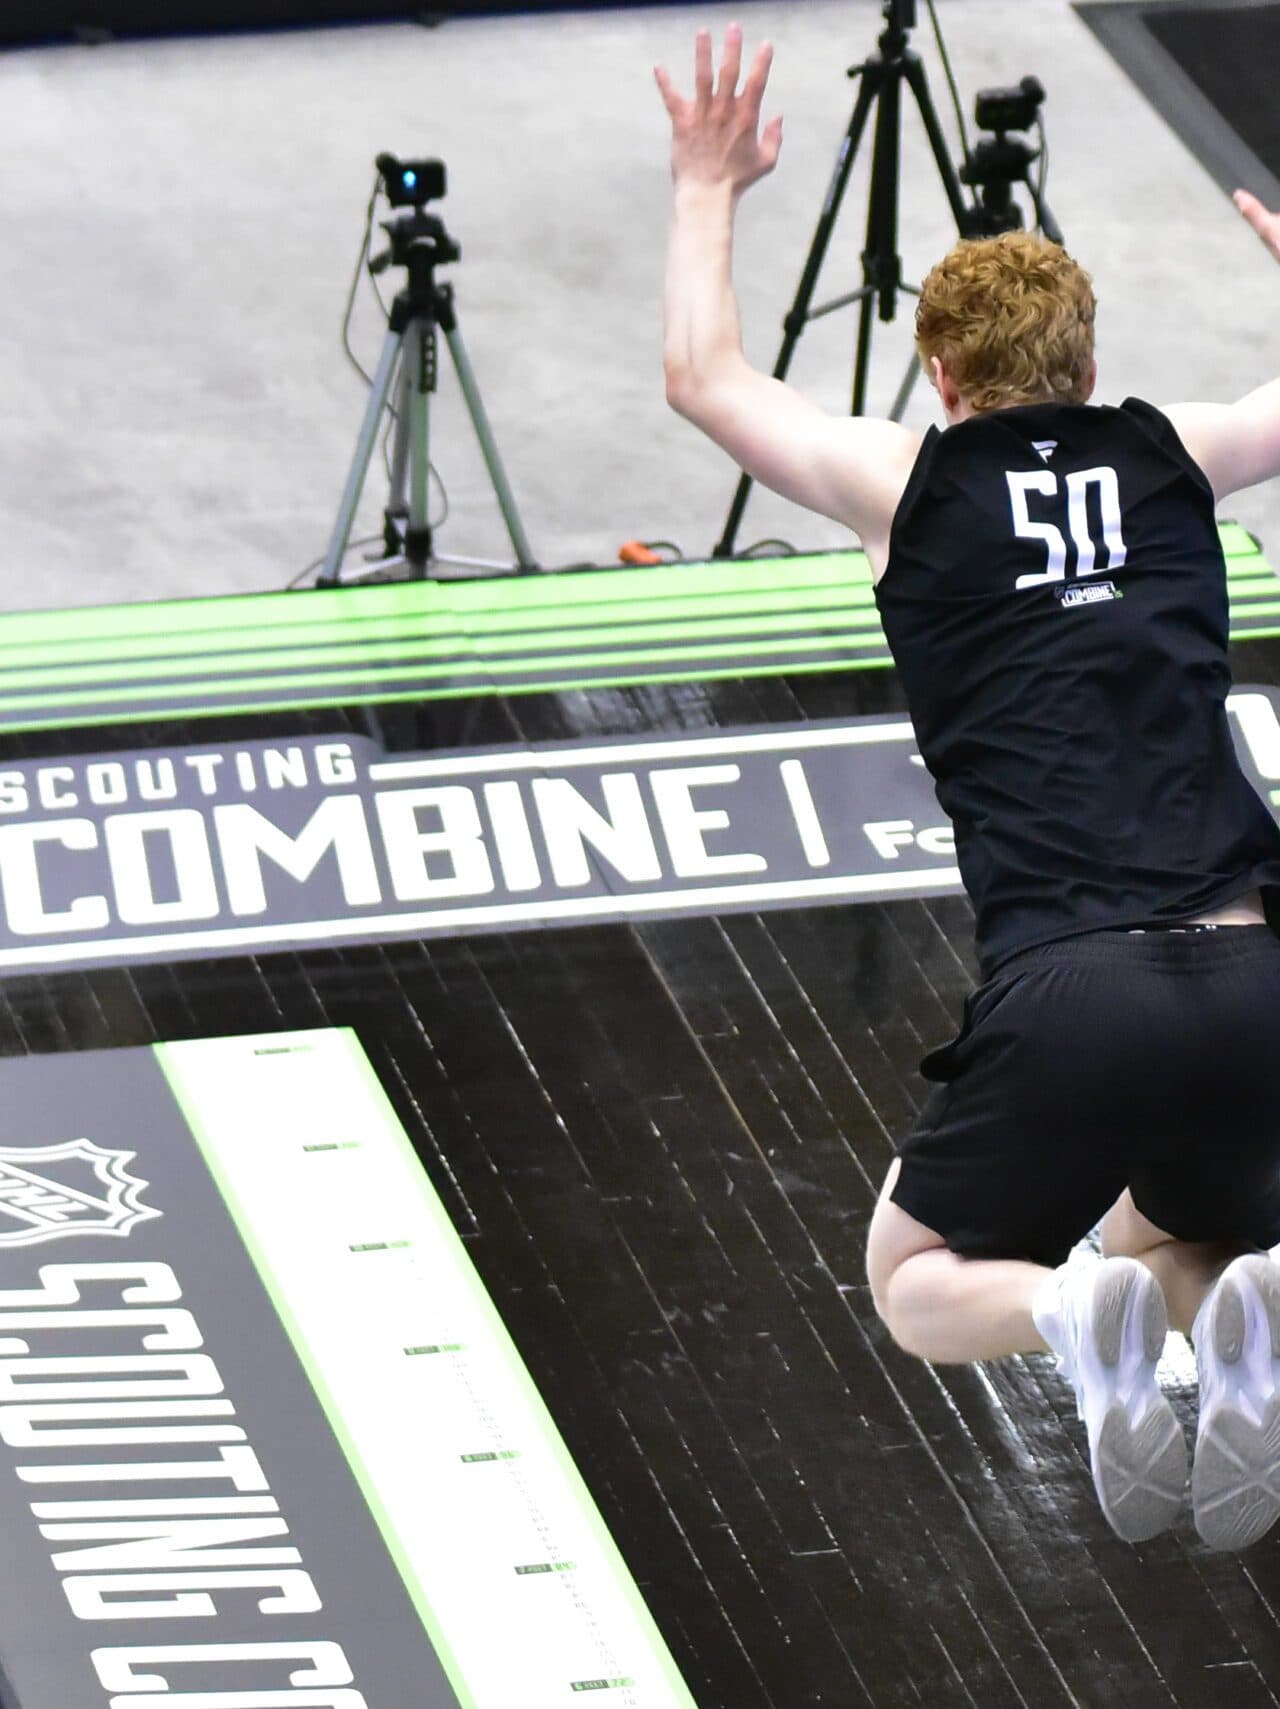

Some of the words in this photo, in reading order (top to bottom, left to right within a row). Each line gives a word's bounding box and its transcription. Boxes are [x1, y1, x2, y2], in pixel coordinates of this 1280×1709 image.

[1005, 466, 1127, 590] 50
[0, 743, 358, 813] SCOUTING
[0, 763, 768, 936] COMBINE
[0, 1262, 323, 1621] SCOUTING
